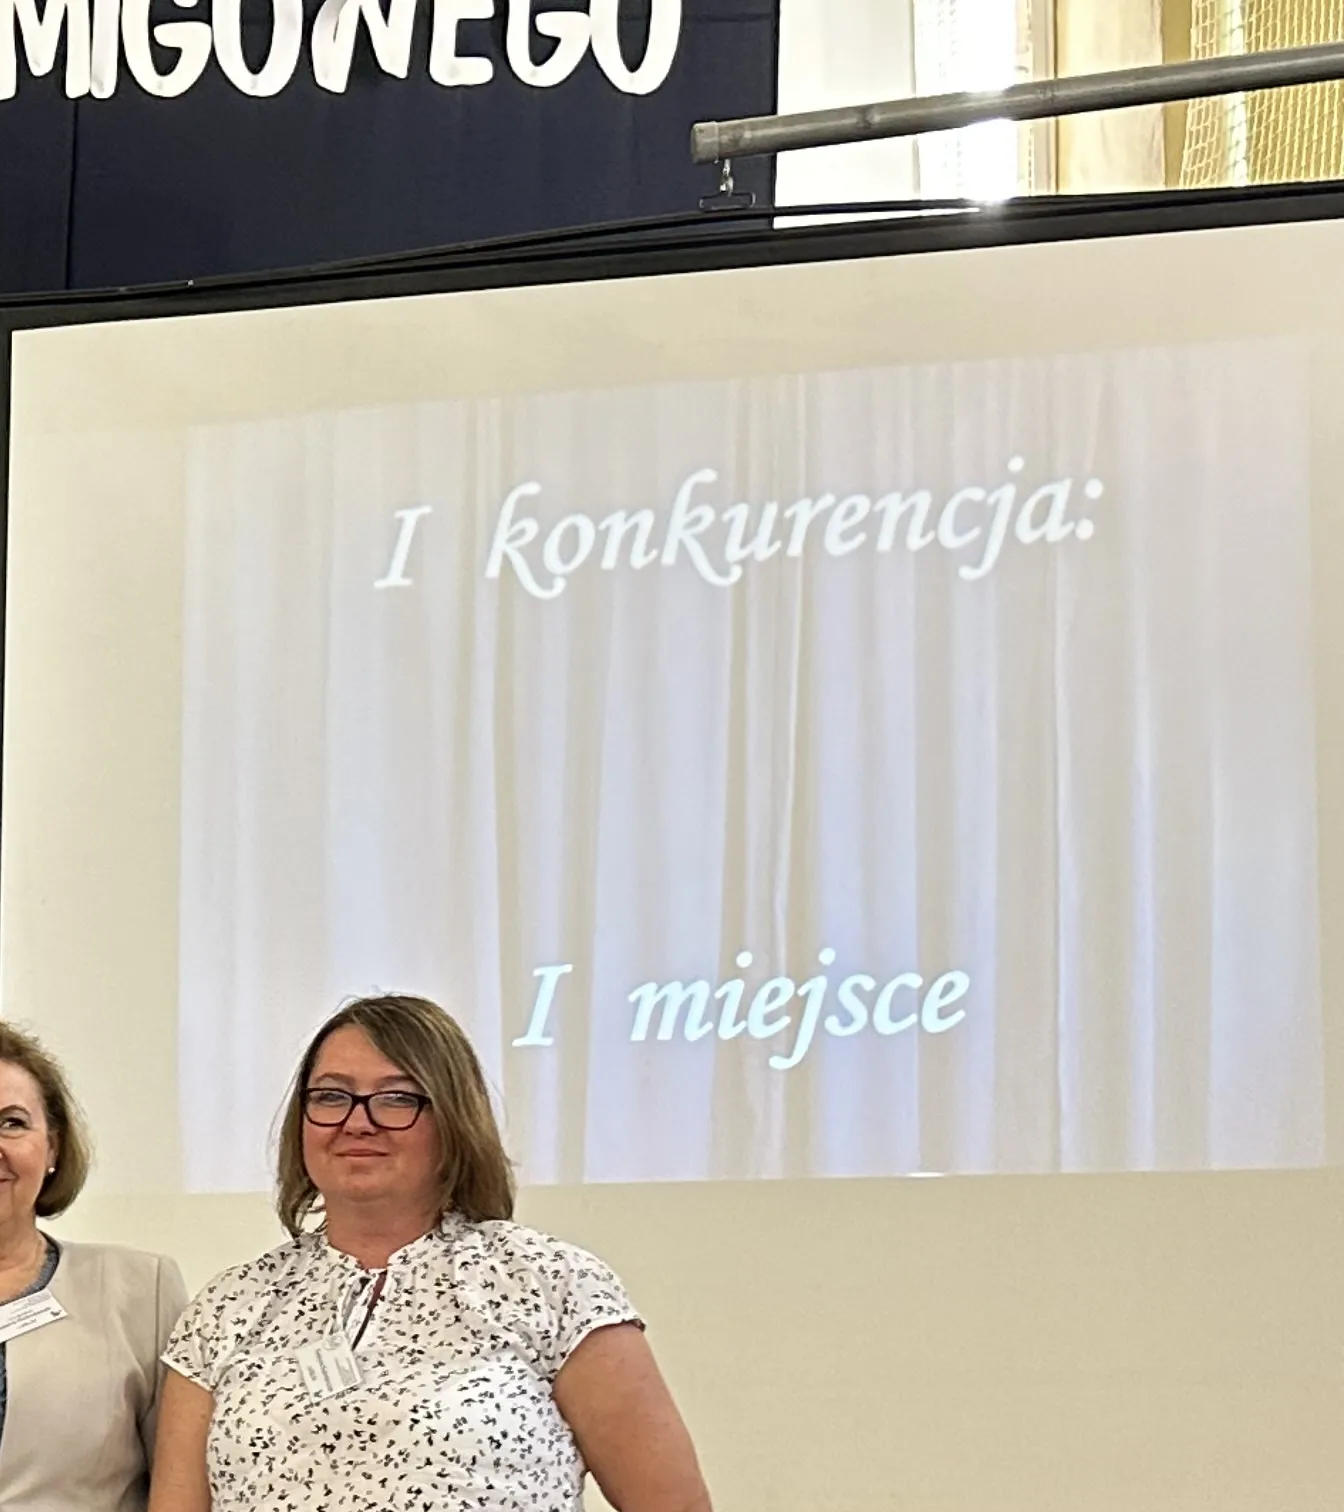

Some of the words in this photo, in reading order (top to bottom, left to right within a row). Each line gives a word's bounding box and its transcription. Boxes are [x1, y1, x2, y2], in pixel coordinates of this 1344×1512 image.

[374, 505, 432, 589] I
[485, 456, 1103, 599] konkurencja:
[512, 964, 573, 1047] I
[629, 947, 971, 1070] miejsce
